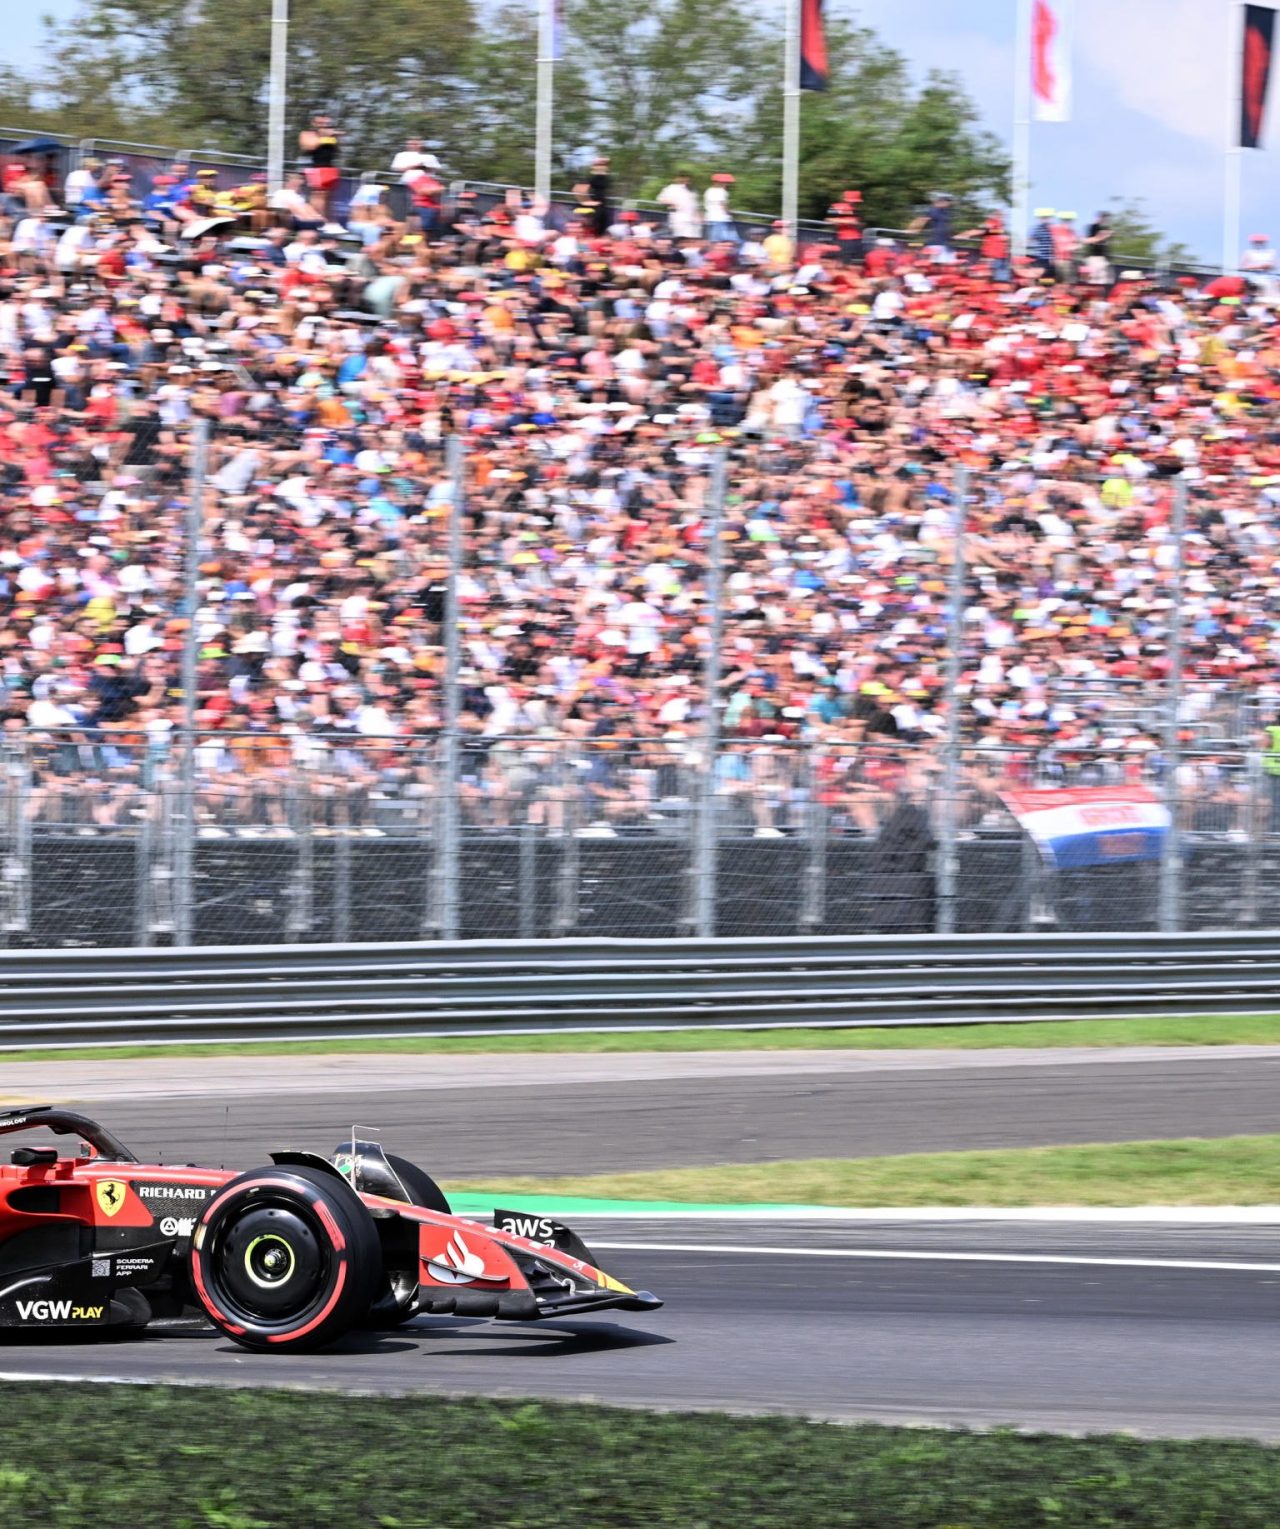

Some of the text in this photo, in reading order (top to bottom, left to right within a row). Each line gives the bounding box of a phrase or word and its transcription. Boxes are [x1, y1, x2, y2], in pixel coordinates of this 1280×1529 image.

[140, 1187, 206, 1200] RICHARD
[502, 1217, 554, 1238] aws
[16, 1301, 104, 1320] VGW PLAY
